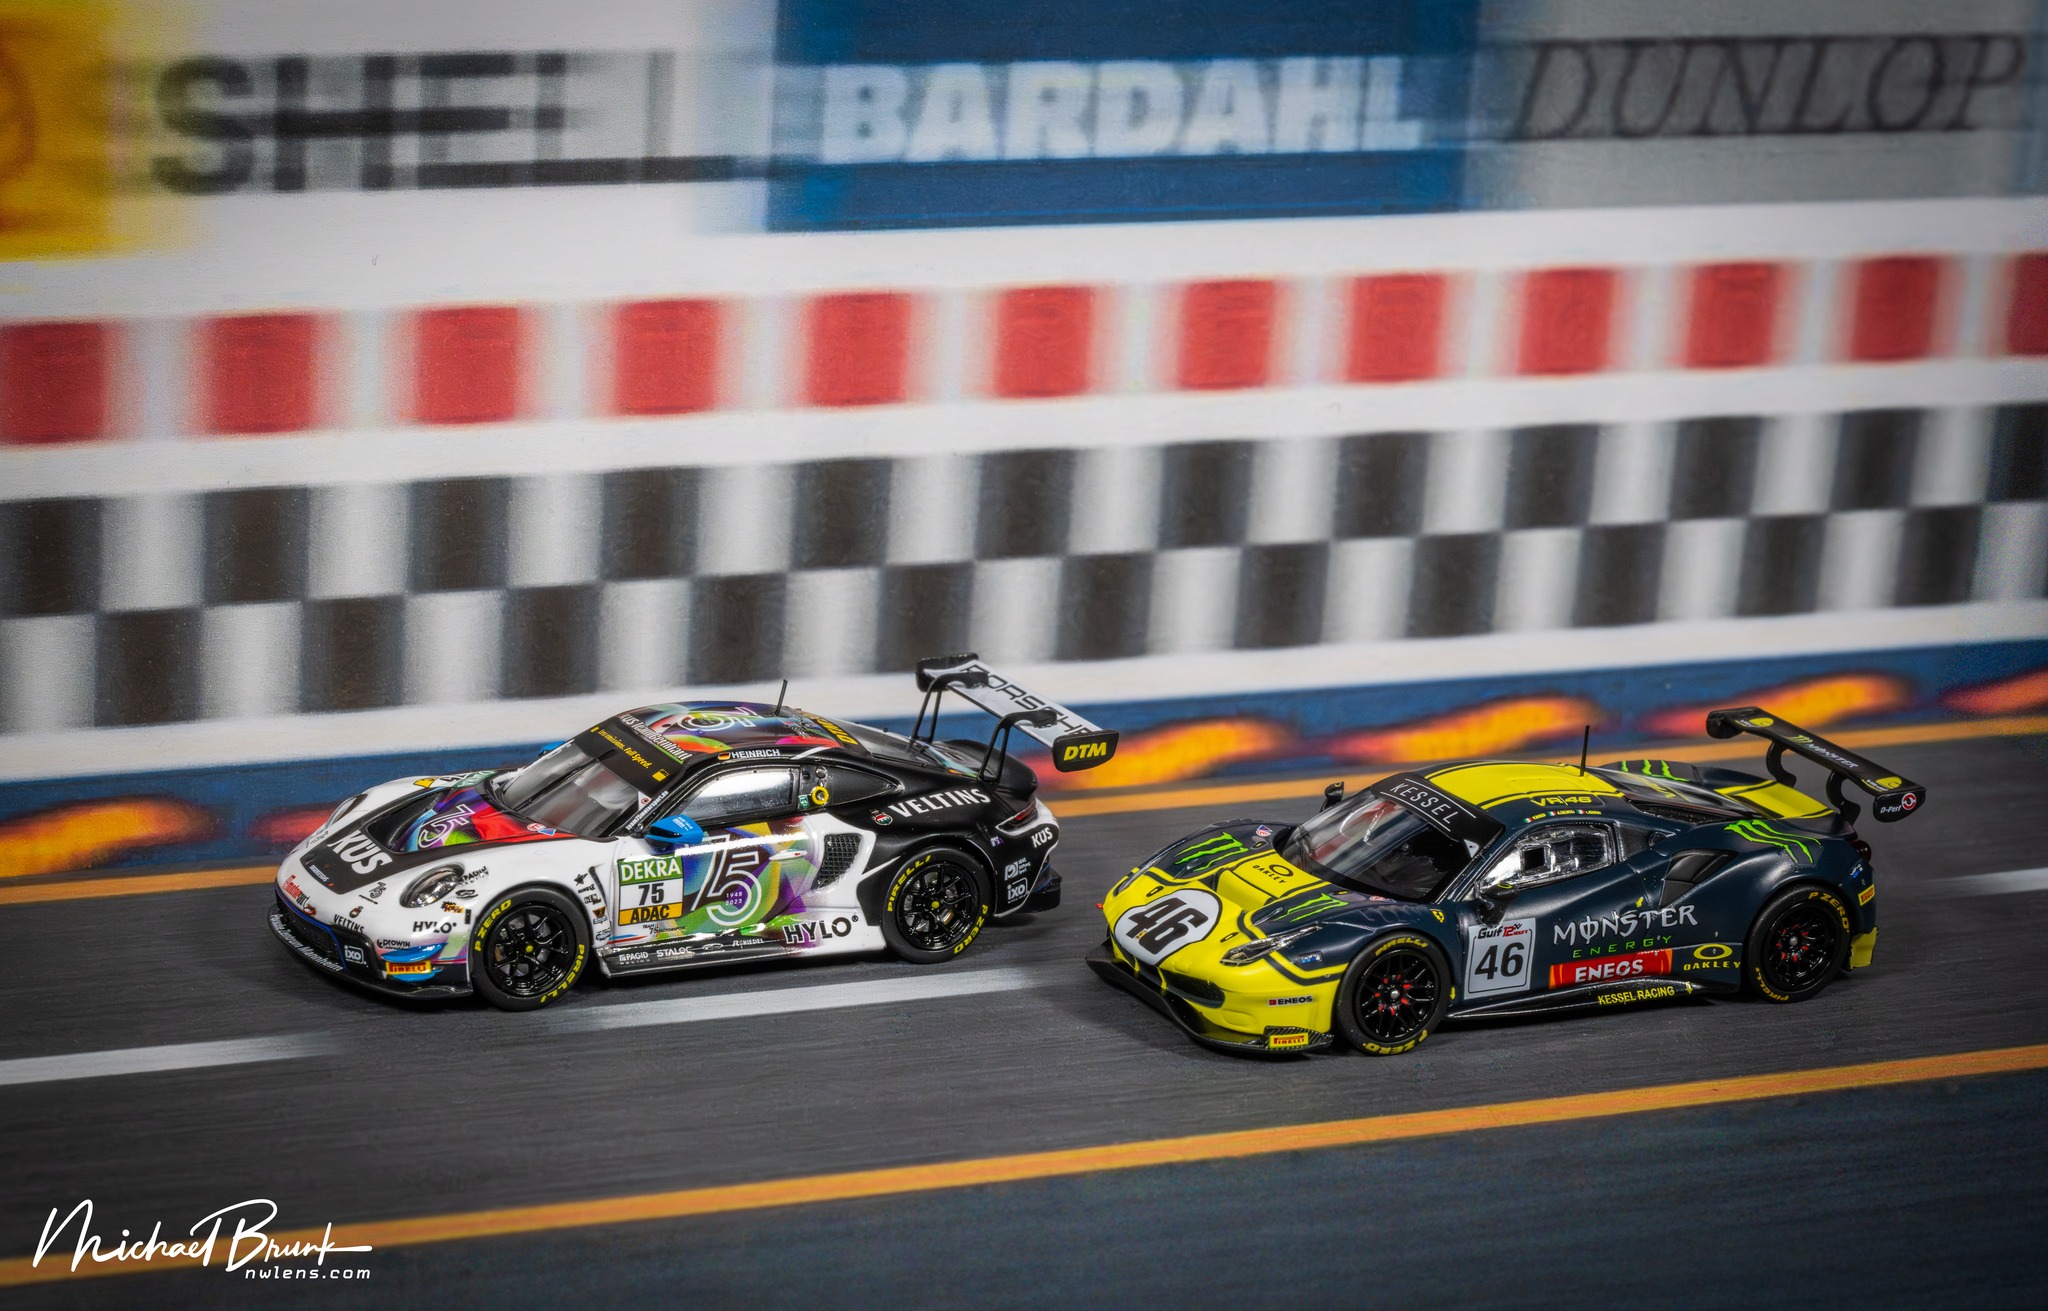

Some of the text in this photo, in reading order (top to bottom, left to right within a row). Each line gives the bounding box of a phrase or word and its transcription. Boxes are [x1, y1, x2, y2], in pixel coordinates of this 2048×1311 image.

[1505, 35, 2025, 143] DUNLOP
[822, 58, 1424, 162] BARDAHL
[731, 749, 781, 759] HEINRICH
[1063, 741, 1108, 762] DTM
[888, 788, 991, 818] VELTINS
[1389, 782, 1459, 825] KESSEL
[327, 829, 393, 875] KÜS
[621, 859, 682, 882] DEKRA
[1252, 864, 1286, 884] OAKLEY
[638, 882, 665, 906] 75
[888, 855, 931, 911] PIRELLI
[630, 904, 670, 923] ADAC
[1808, 891, 1850, 930] P ZERO
[333, 913, 365, 933] VELTINS
[474, 899, 512, 951] P ZERO
[954, 904, 989, 954] P ZERO
[1126, 898, 1209, 955] 46
[1502, 925, 1516, 938] 12
[1553, 904, 1699, 946] MONSTER
[625, 951, 649, 961] PAGID
[656, 946, 693, 958] STALOC
[1375, 937, 1428, 956] PIRELLI
[1573, 935, 1672, 958] ENERGY
[1474, 942, 1525, 980] 46
[1575, 959, 1644, 983] ENEOS
[1683, 961, 1741, 971] OAKLEY
[541, 944, 585, 1003] PIRELLI
[1277, 995, 1313, 1005] ENEOS
[1598, 986, 1676, 1005] KESSEL RACING
[1273, 1035, 1305, 1045] PIRELLI
